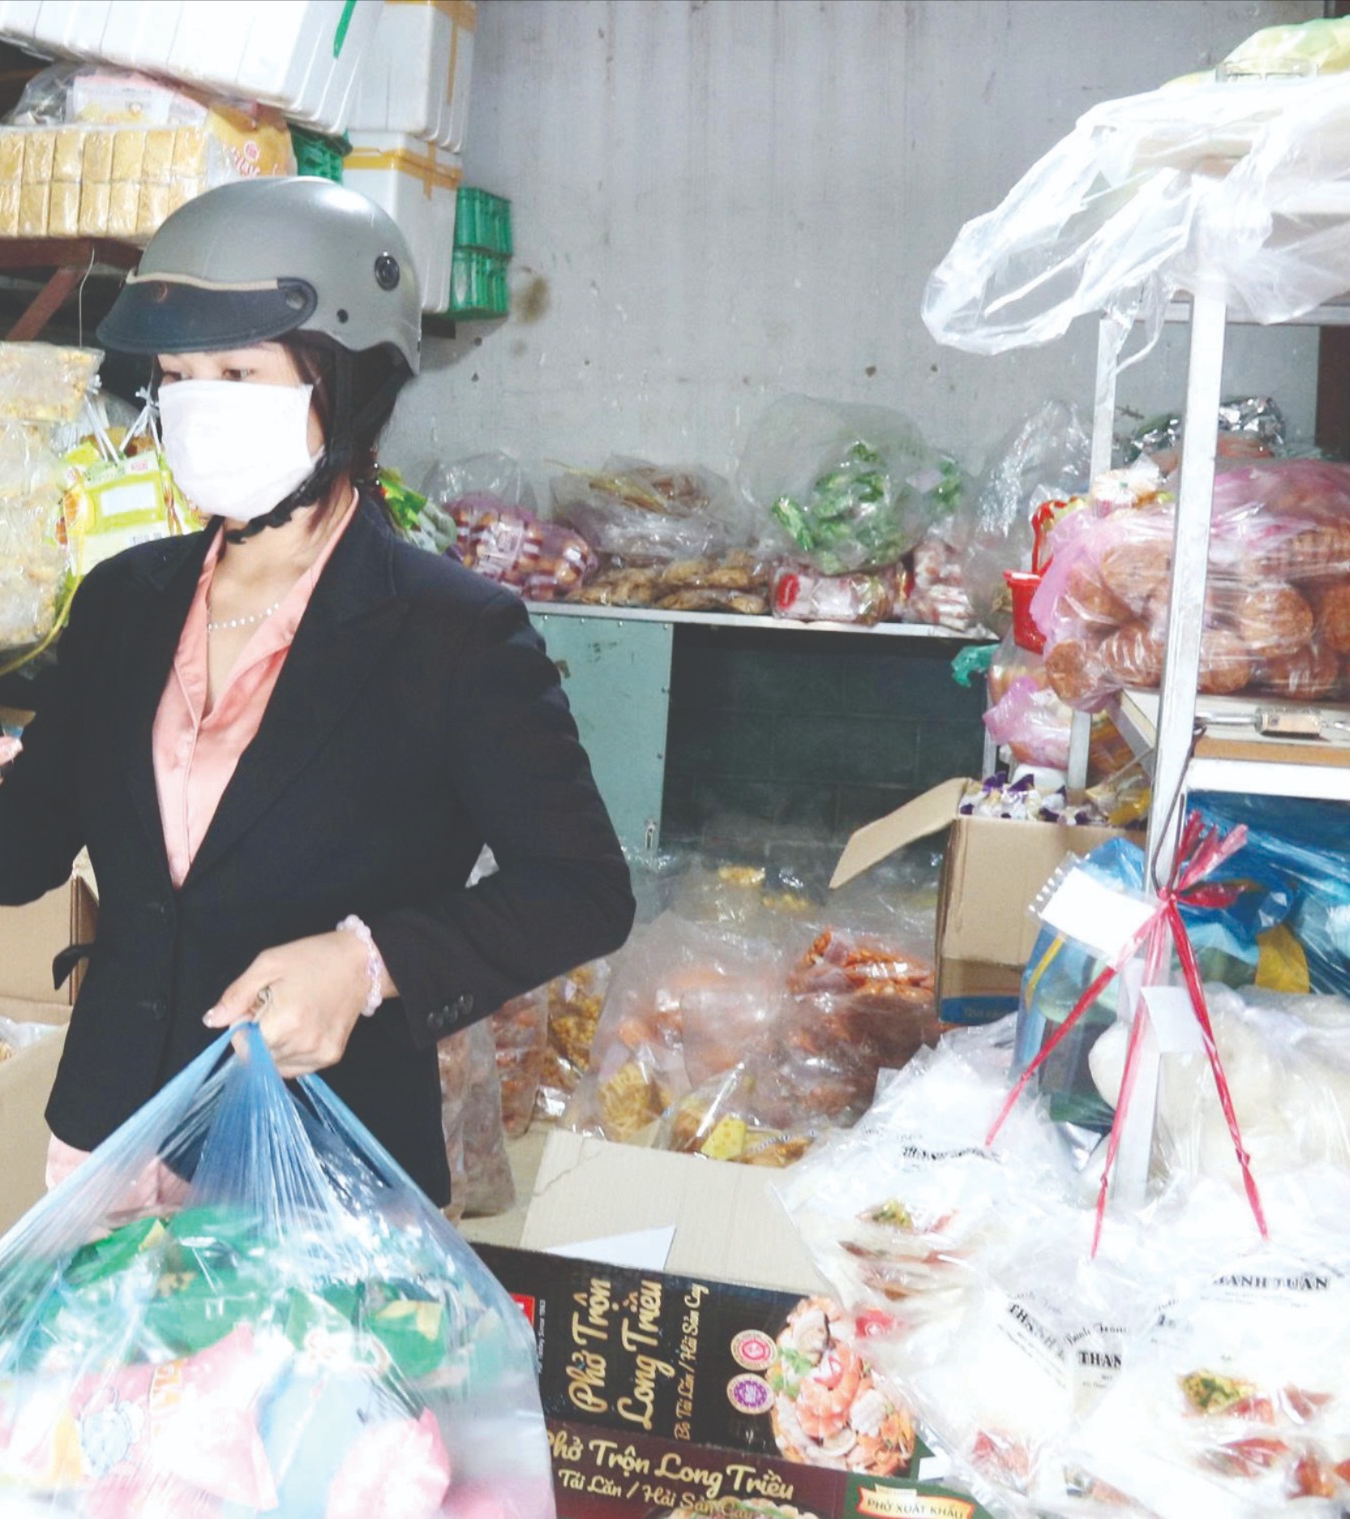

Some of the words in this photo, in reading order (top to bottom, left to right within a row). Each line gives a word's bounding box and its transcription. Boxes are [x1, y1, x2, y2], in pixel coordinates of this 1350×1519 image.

[571, 1277, 620, 1346] Trộn
[621, 1279, 663, 1352] Triều
[683, 1283, 710, 1309] Cay
[566, 1350, 608, 1413] Phở
[616, 1354, 675, 1431] Long
[589, 1439, 650, 1477] Trộn
[654, 1453, 723, 1499] Long
[725, 1464, 794, 1501] Triều
[642, 1485, 676, 1508] Hải
